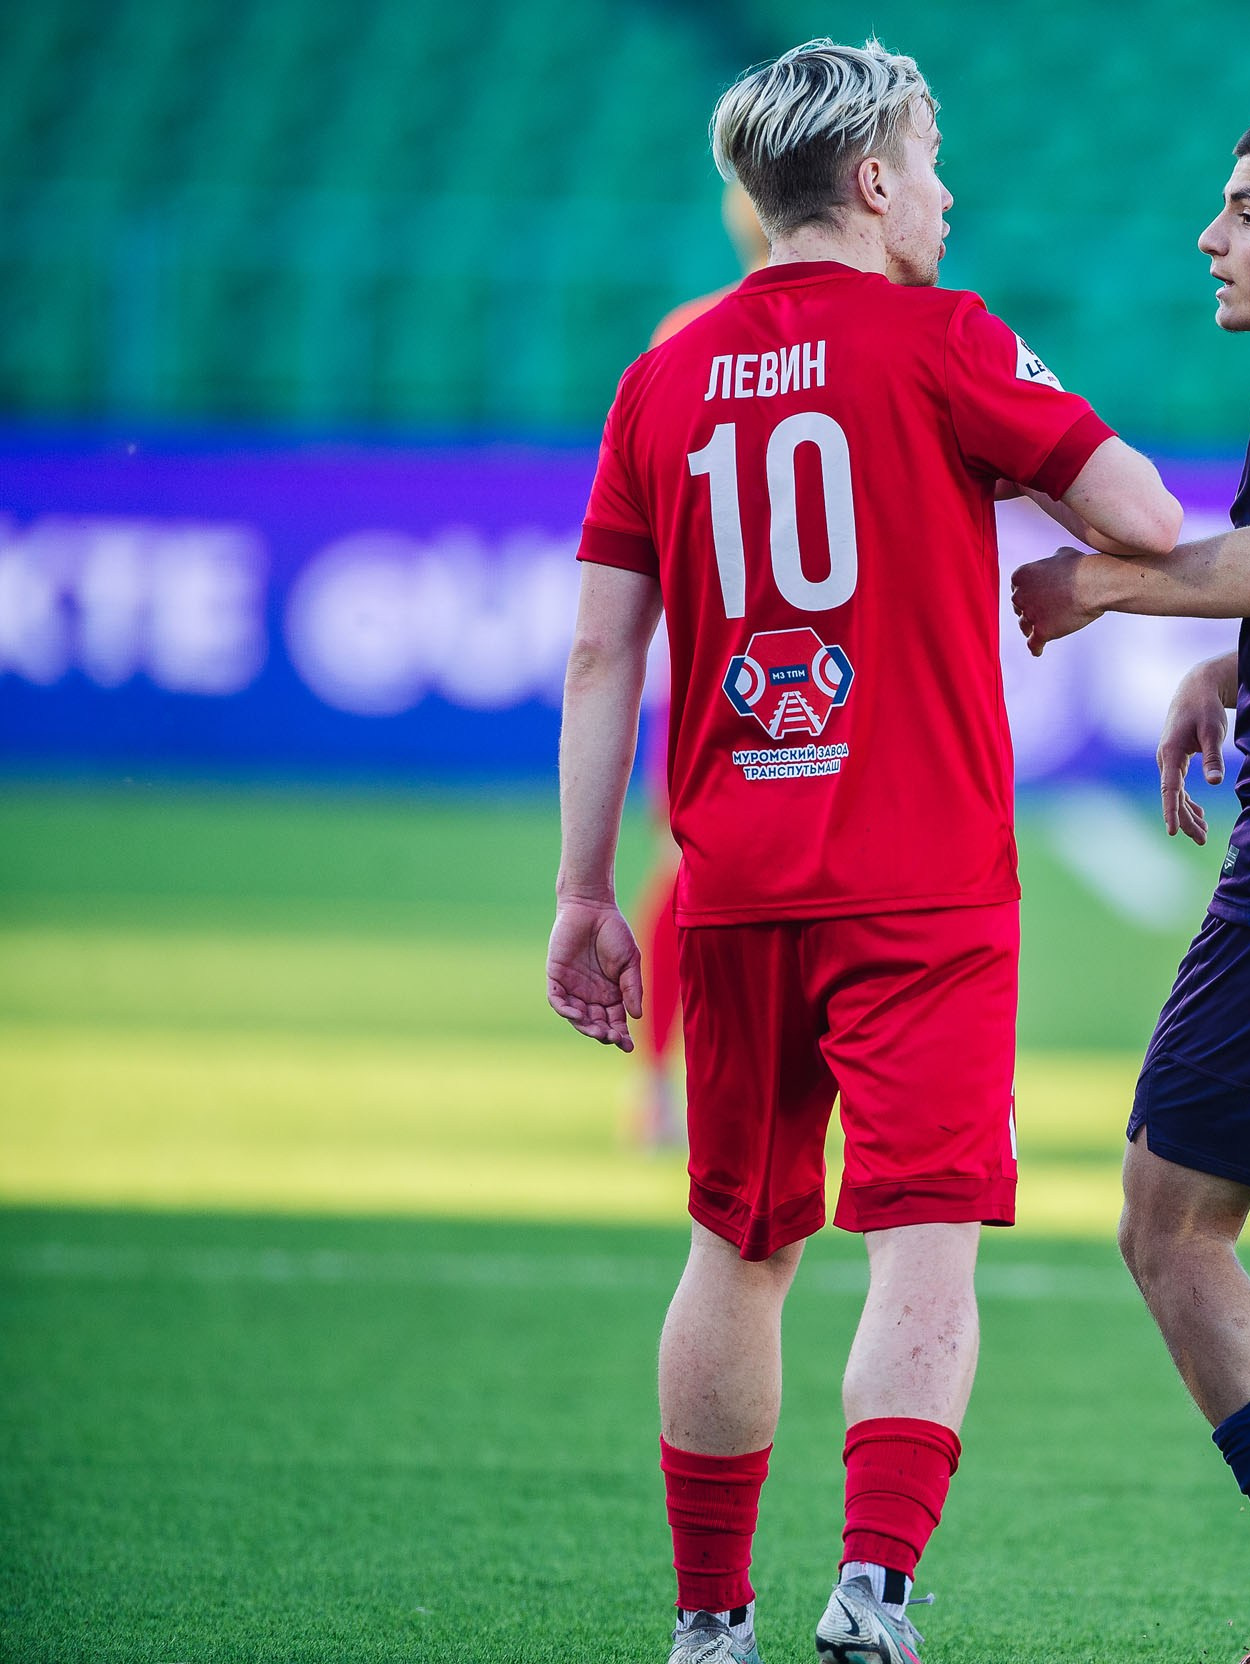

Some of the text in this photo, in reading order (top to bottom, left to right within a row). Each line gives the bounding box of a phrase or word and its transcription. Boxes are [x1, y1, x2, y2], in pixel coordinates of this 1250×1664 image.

[704, 340, 825, 401] ЛЕВИН
[687, 411, 858, 619] 10
[786, 669, 806, 678] ТПМ
[733, 744, 848, 764] МУРОМСКИЙ ЗАВОД
[744, 761, 840, 779] ТРАНСПУТЬМАШ
